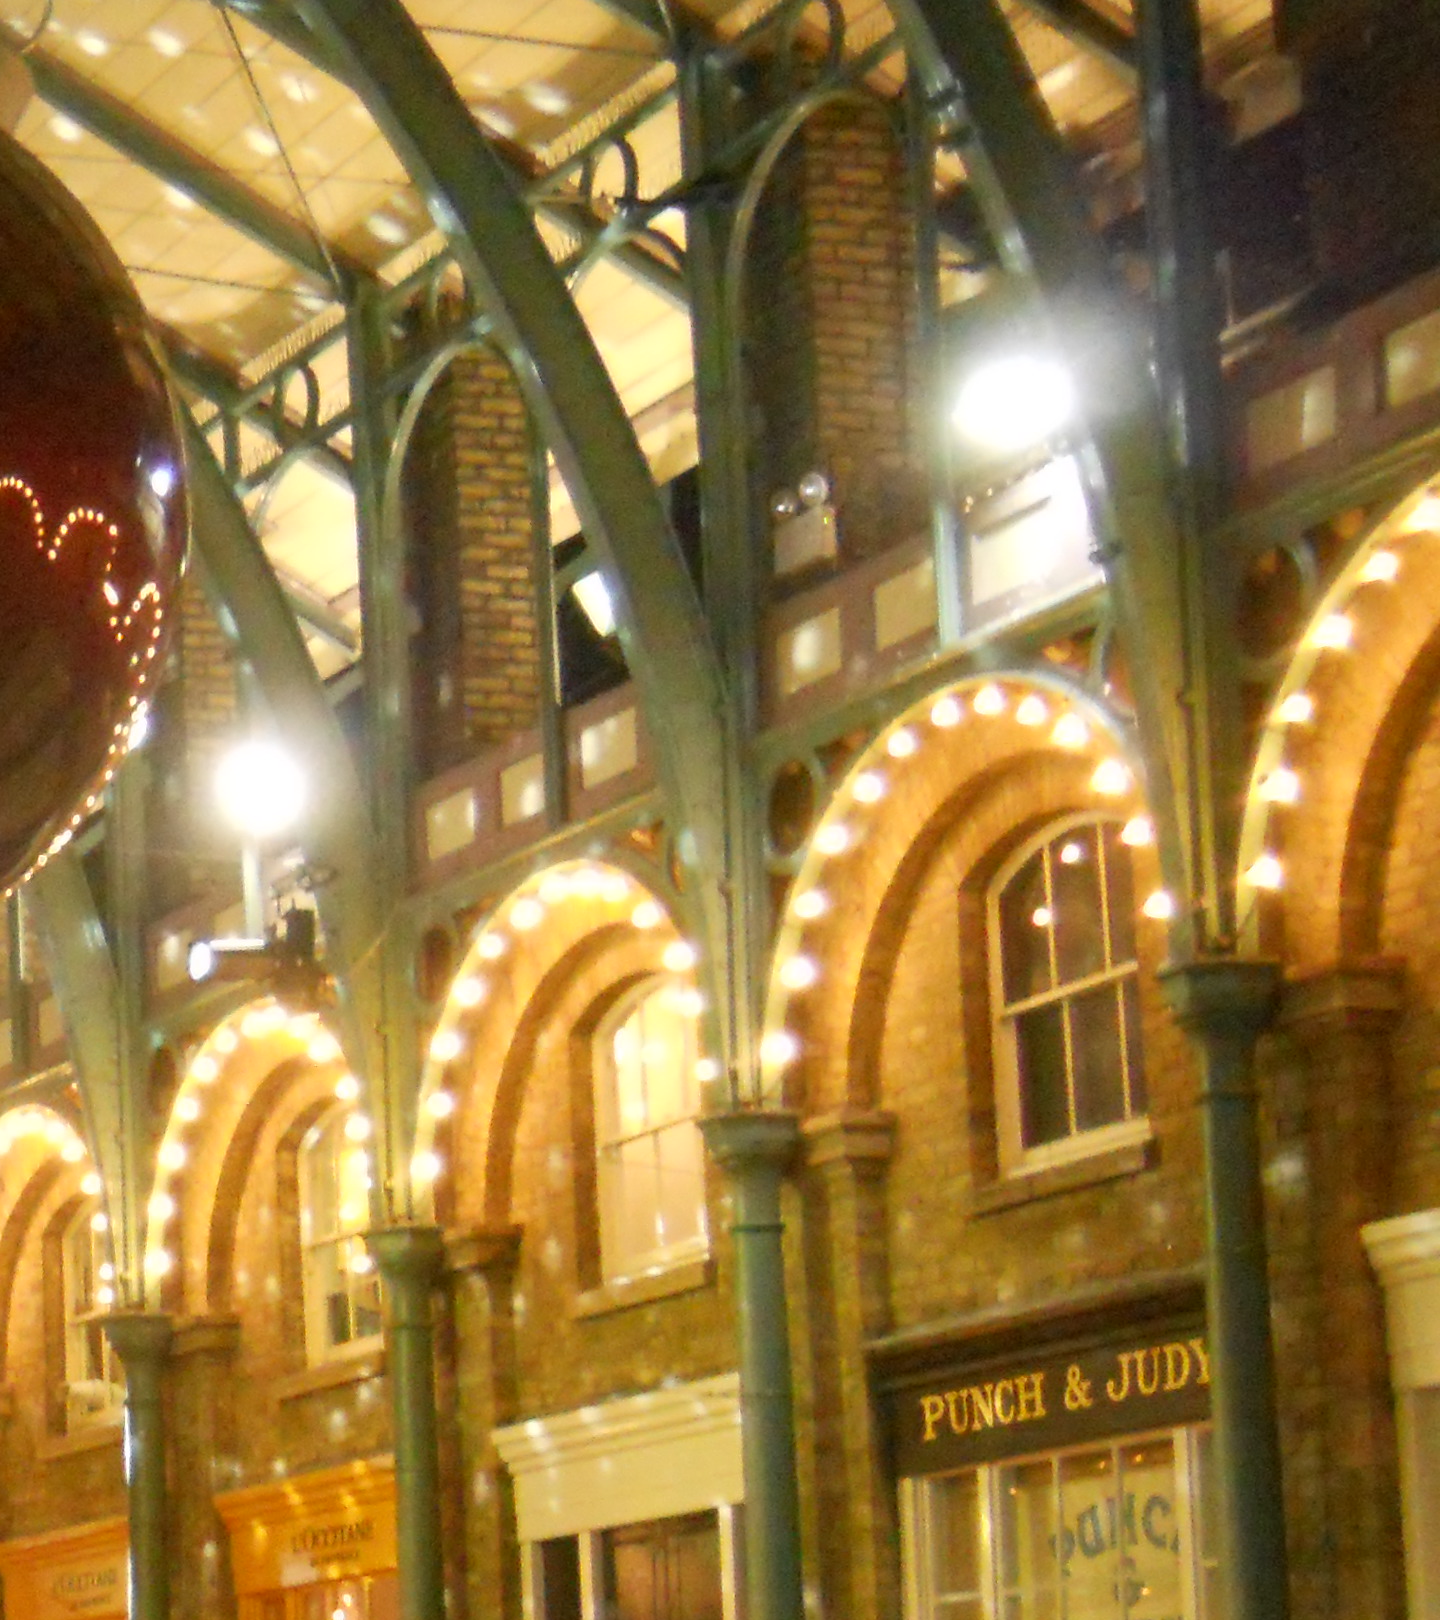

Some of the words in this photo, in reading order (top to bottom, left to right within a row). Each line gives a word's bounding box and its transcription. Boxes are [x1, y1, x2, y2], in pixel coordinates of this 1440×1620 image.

[920, 1372, 1047, 1441] PUNCH
[1064, 1363, 1093, 1410] &
[1106, 1338, 1211, 1402] JUDY
[1048, 1492, 1180, 1577] PUNC
